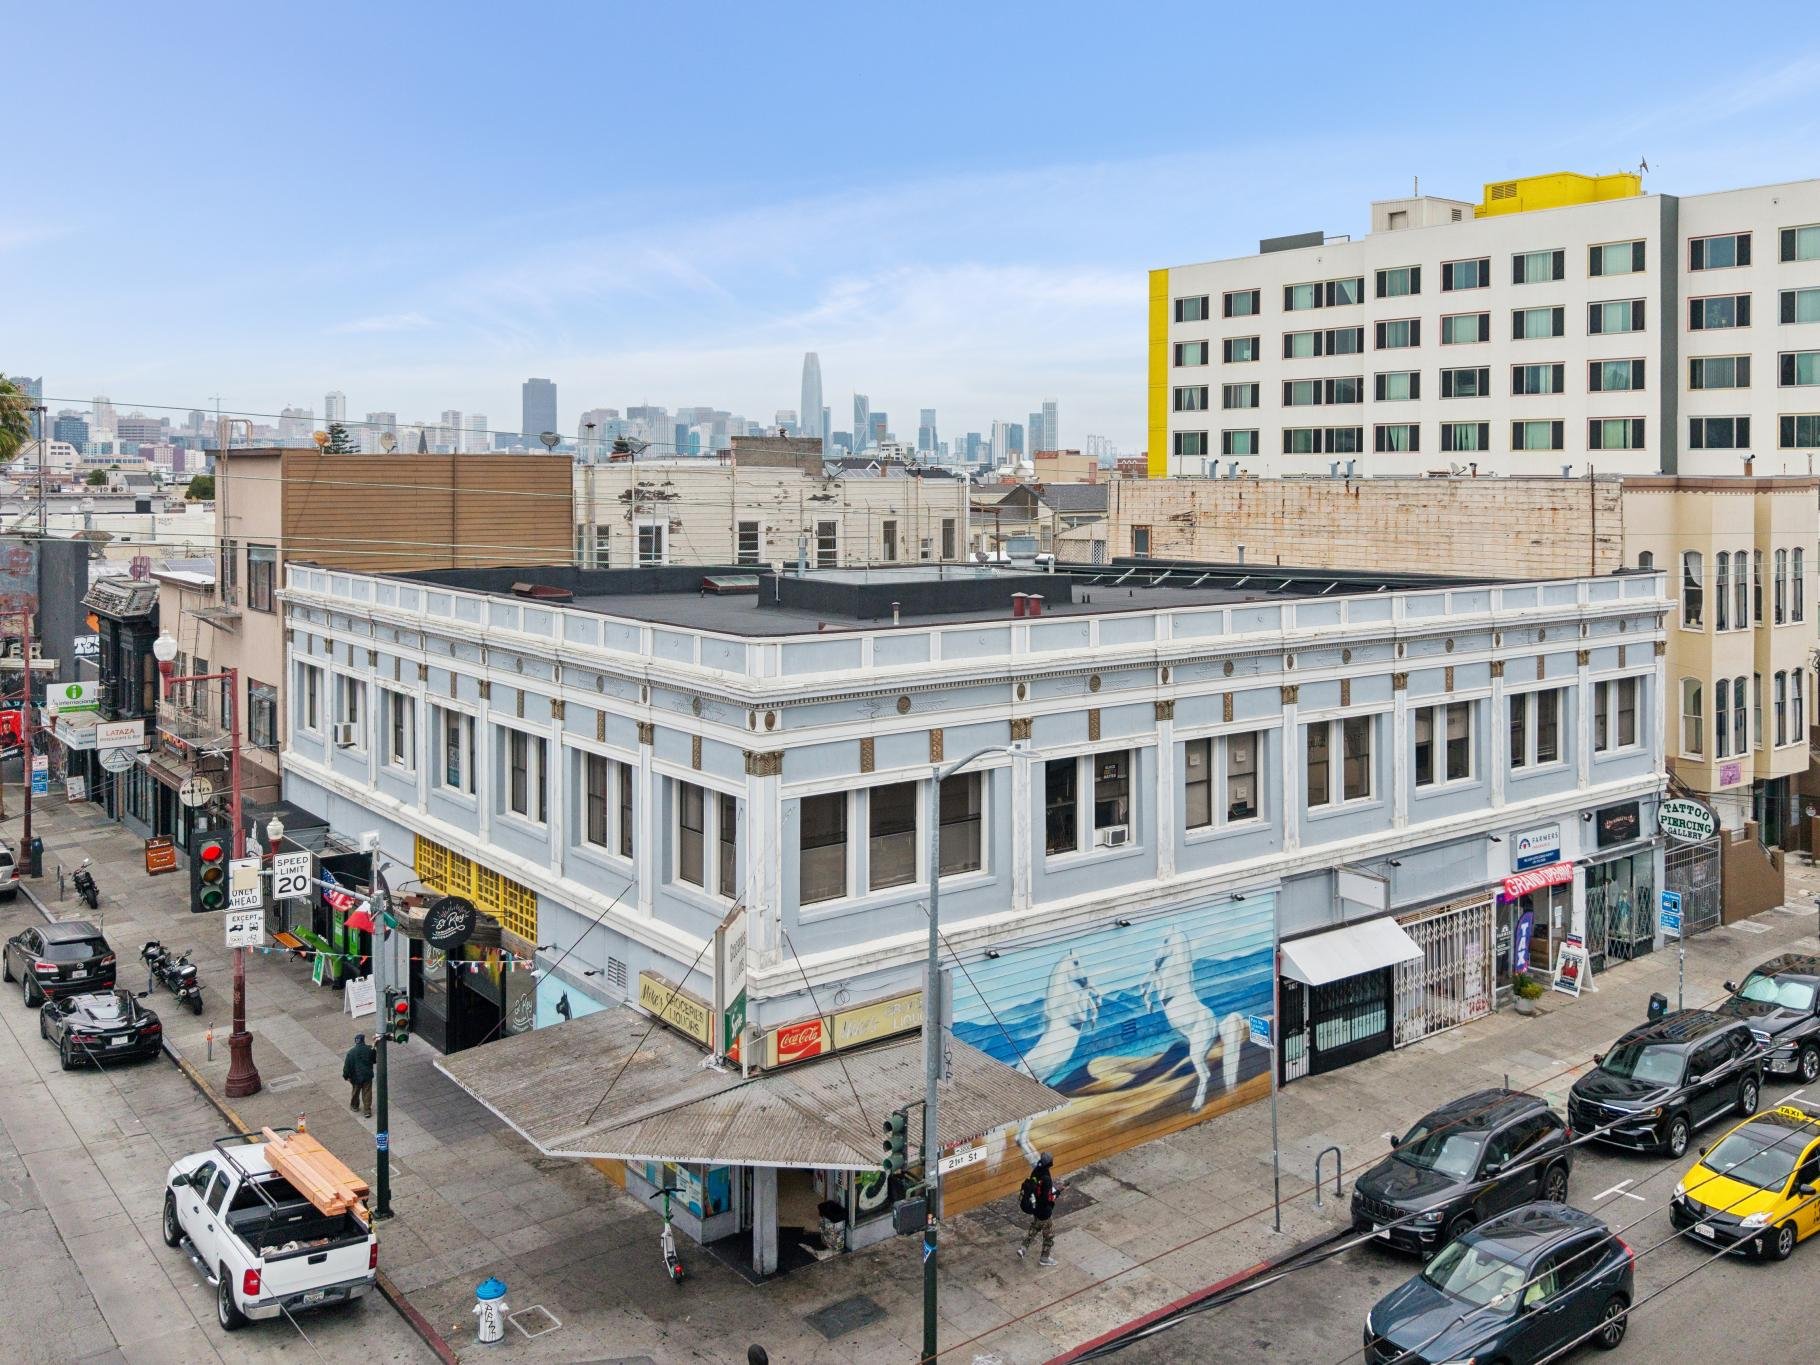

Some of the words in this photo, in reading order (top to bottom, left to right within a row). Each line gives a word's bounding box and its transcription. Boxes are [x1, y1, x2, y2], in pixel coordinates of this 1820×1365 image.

[1663, 803, 1710, 821] TATTOO
[1660, 815, 1712, 834] PIERCING
[1532, 831, 1559, 843] FARMERS
[1667, 827, 1703, 840] GALLERY
[277, 856, 309, 867] SPEED
[280, 866, 304, 875] LIMIT
[278, 875, 307, 894] 20
[1506, 872, 1546, 896] GRAND
[230, 895, 257, 907] AHEAD
[232, 914, 257, 922] EXCEPT
[446, 911, 465, 929] Rey
[1517, 922, 1529, 967] TAX
[1780, 1107, 1800, 1117] TAXI
[948, 1156, 964, 1169] 21st
[968, 1152, 977, 1162] St
